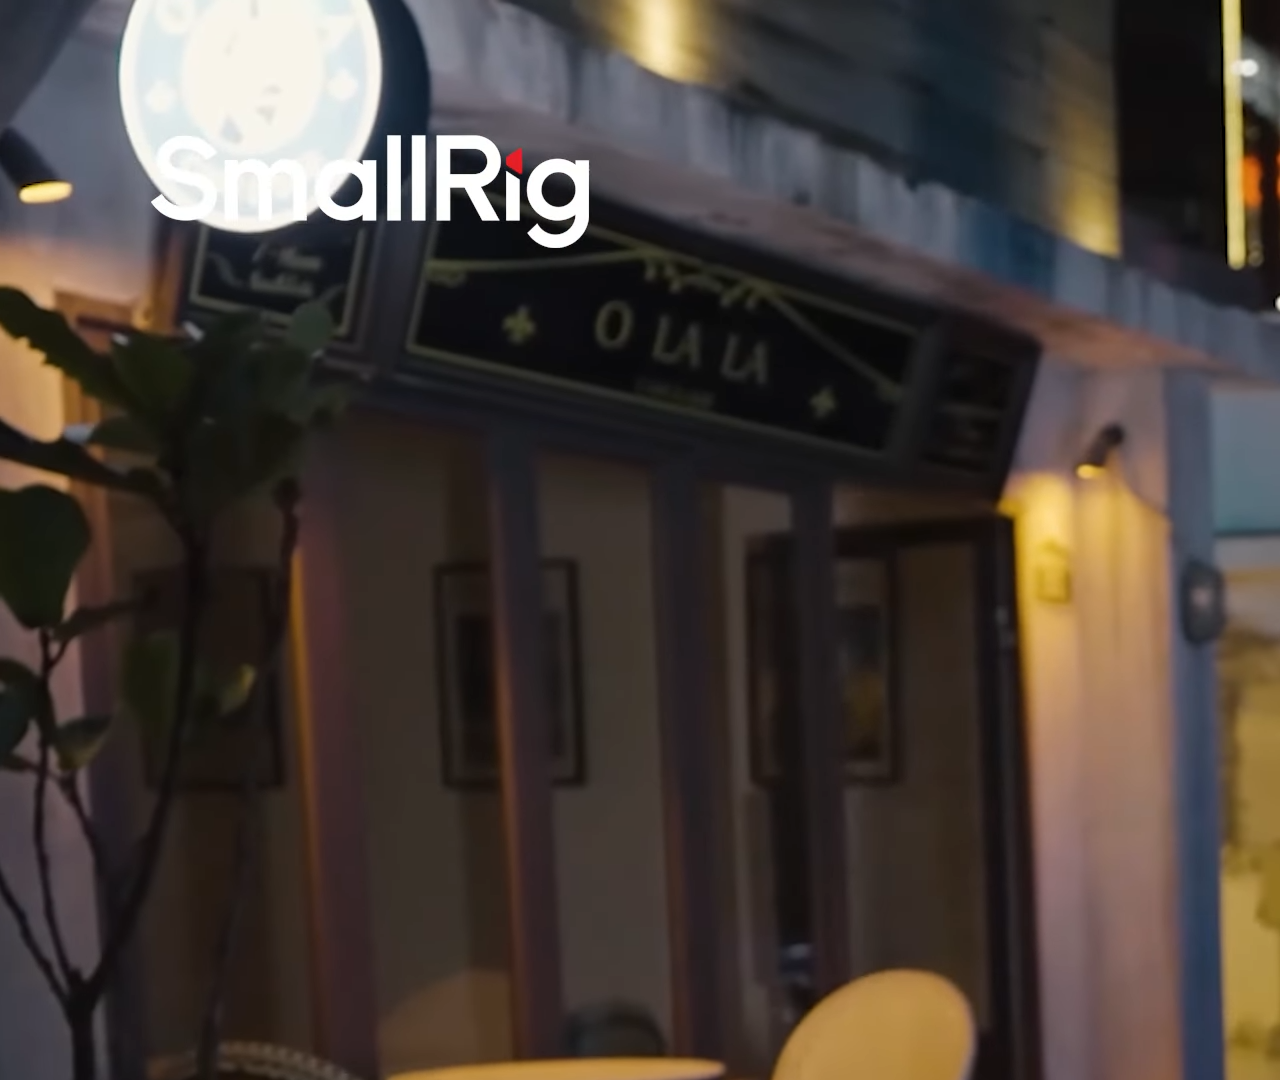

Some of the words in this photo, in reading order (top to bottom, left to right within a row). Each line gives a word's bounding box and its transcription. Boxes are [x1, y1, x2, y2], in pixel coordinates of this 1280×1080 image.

[595, 300, 633, 349] O
[651, 313, 700, 371] LA
[720, 333, 769, 386] LA
